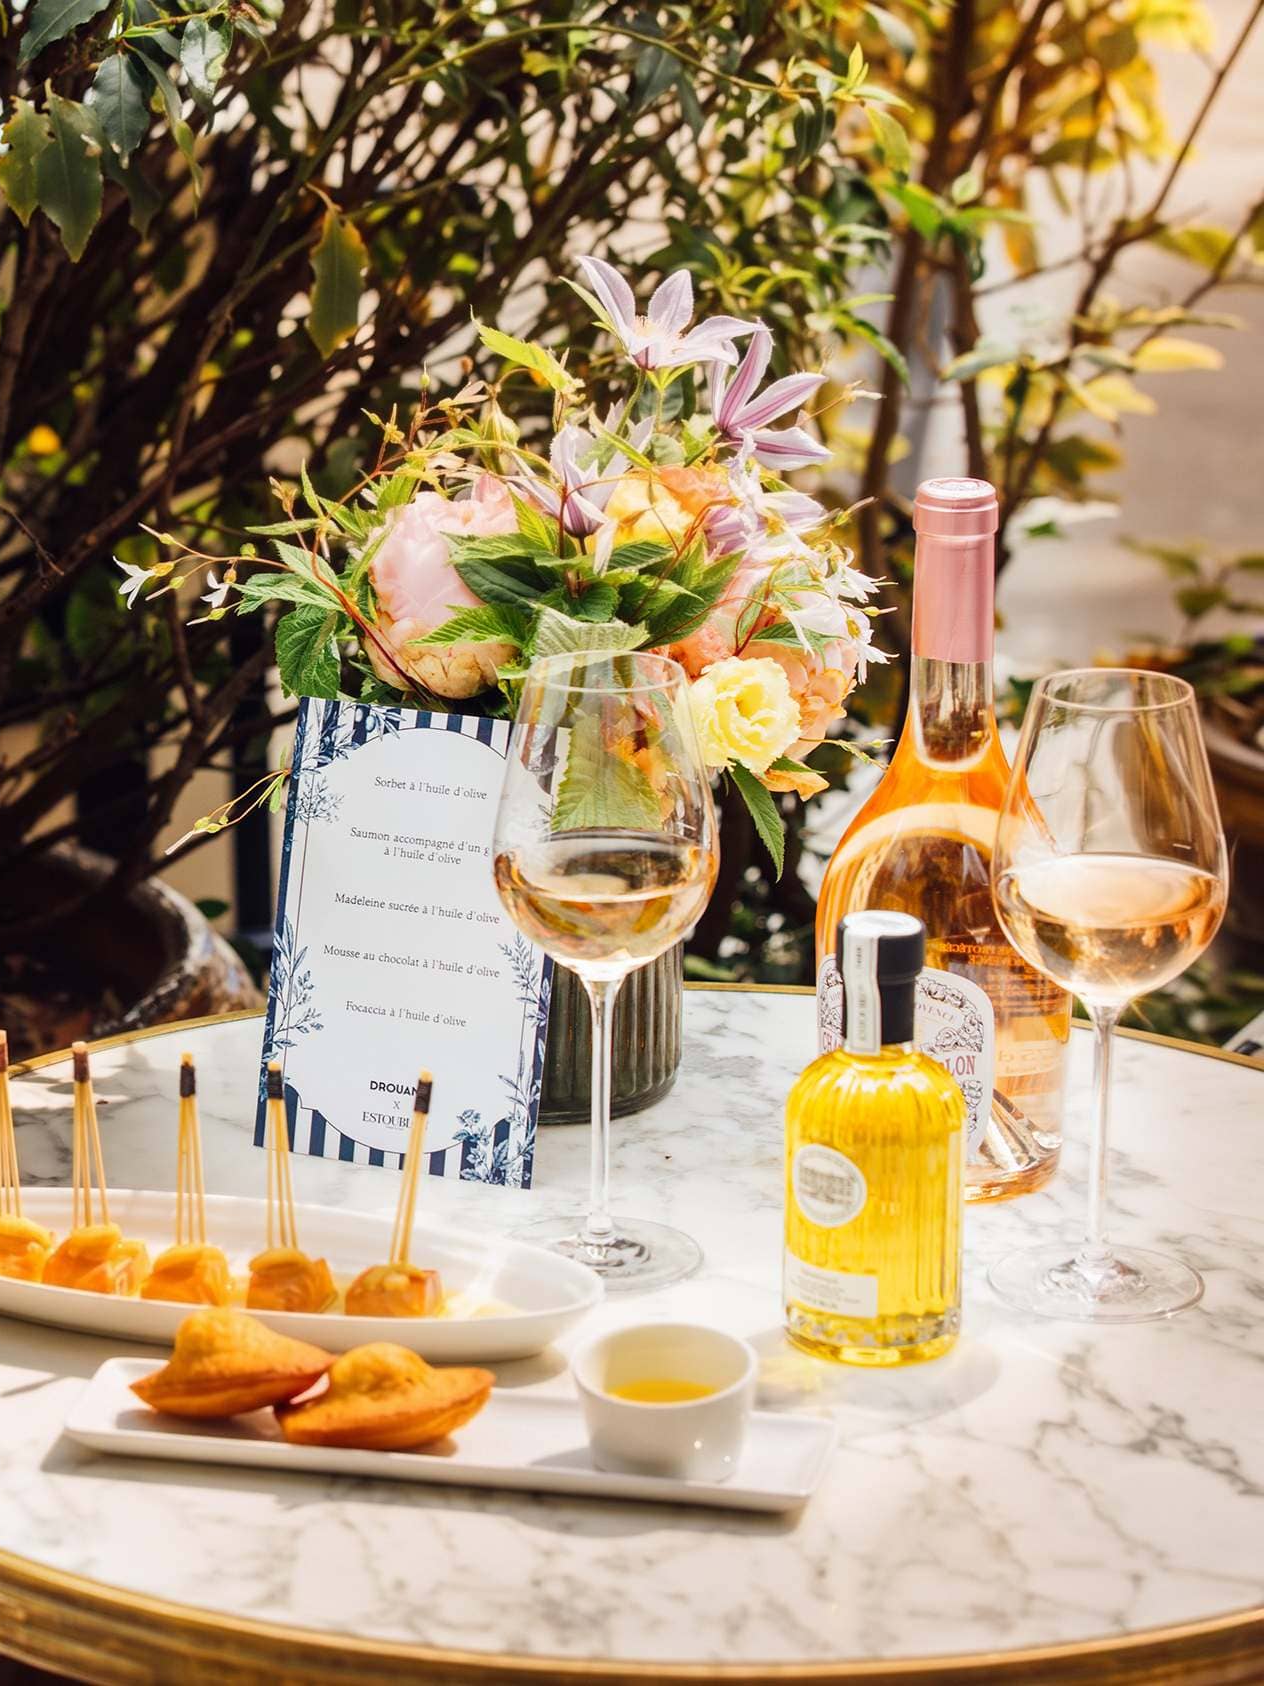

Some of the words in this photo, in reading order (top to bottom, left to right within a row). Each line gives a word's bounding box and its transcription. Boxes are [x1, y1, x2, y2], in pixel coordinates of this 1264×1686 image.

[374, 776, 406, 790] Sorbet
[409, 781, 416, 791] à
[418, 782, 451, 796] l'huile
[453, 787, 488, 800] d'olive
[350, 827, 390, 842] Saumon
[393, 833, 455, 851] accompagné
[457, 841, 482, 854] d'un
[383, 846, 390, 856] à
[393, 847, 425, 861] l'huile
[427, 852, 462, 865] d'olive
[334, 892, 386, 909] Madeleine
[388, 902, 420, 914] sucrée
[421, 905, 428, 915] à
[431, 905, 463, 919] l'huile
[466, 911, 501, 924] d'olive
[323, 944, 361, 959] Mousse
[363, 952, 376, 961] au
[378, 953, 419, 968] chocolat
[422, 959, 429, 969] à
[431, 959, 464, 974] l'huile
[466, 965, 501, 979] d'olive
[345, 1001, 387, 1016] Focaccia
[389, 1007, 396, 1017] à
[398, 1008, 430, 1022] l'huile
[433, 1014, 467, 1028] d'olive
[369, 1080, 418, 1096] DROUAN
[362, 1111, 411, 1129] ESTOUBL
